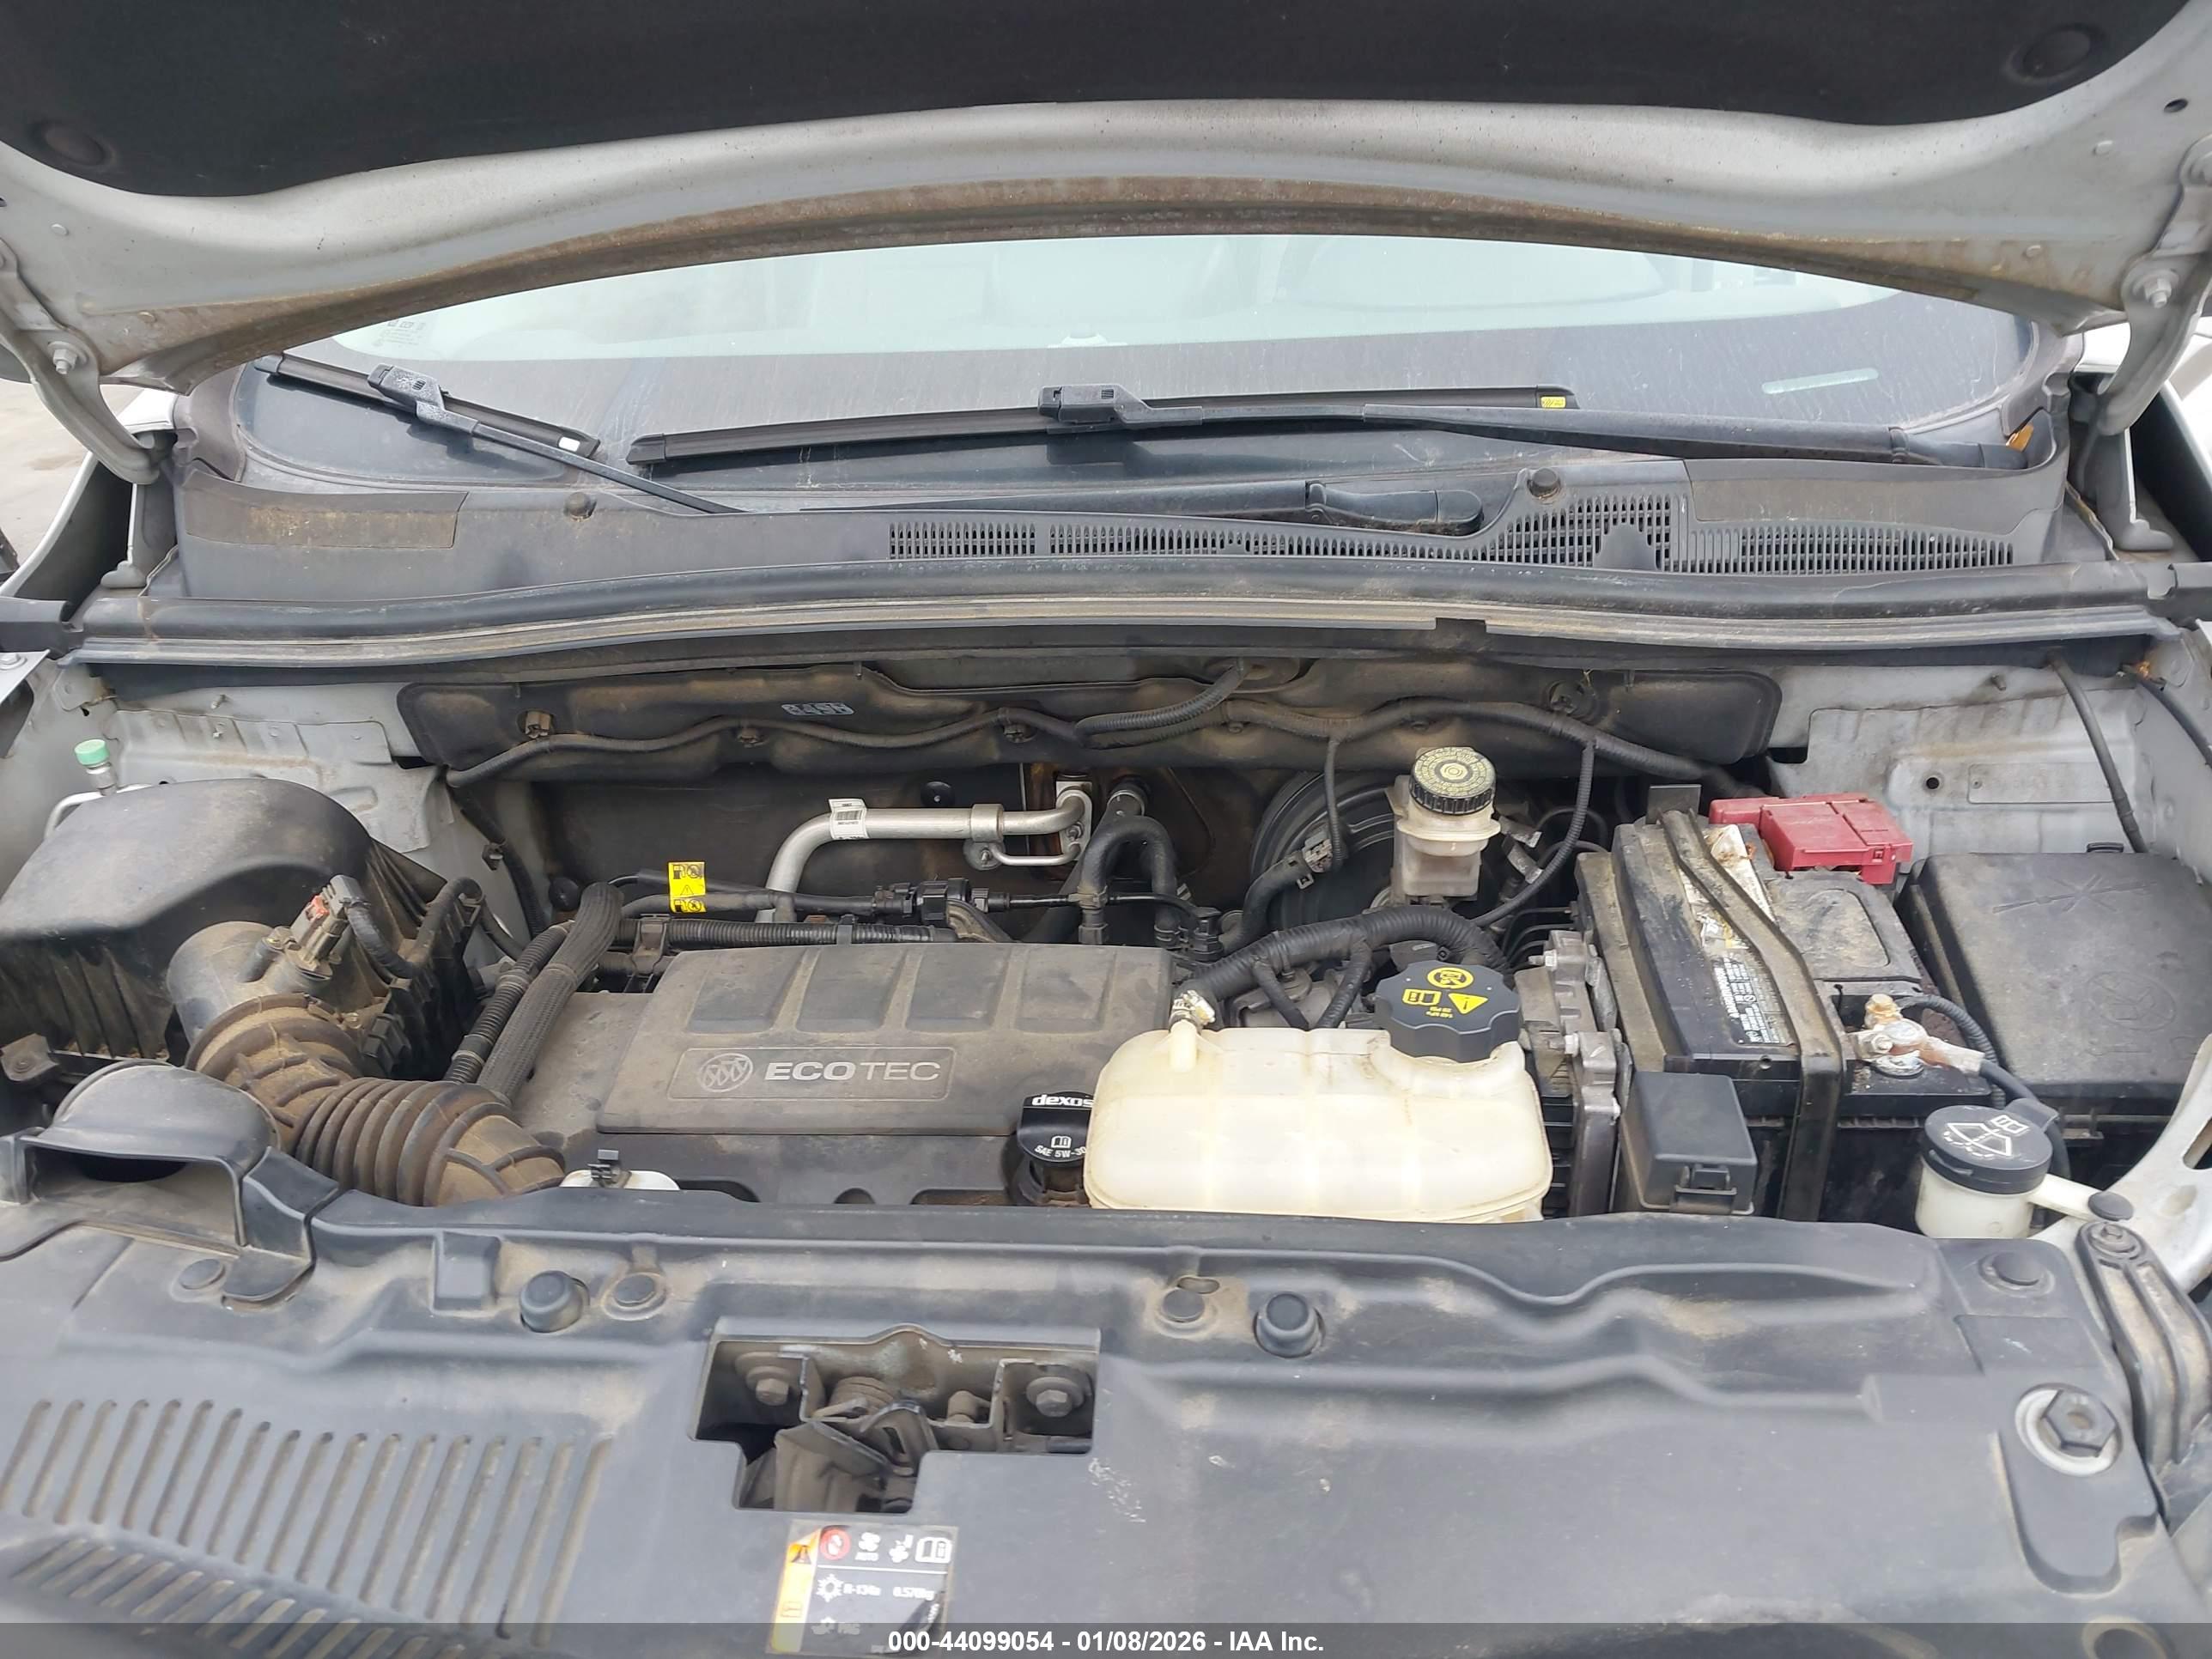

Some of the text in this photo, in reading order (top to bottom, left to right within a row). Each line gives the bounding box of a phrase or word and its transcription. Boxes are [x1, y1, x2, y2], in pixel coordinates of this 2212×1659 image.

[764, 1061, 941, 1081] ECOTEC
[1031, 1094, 1095, 1108] dexos
[1034, 1144, 1054, 1158] SAE
